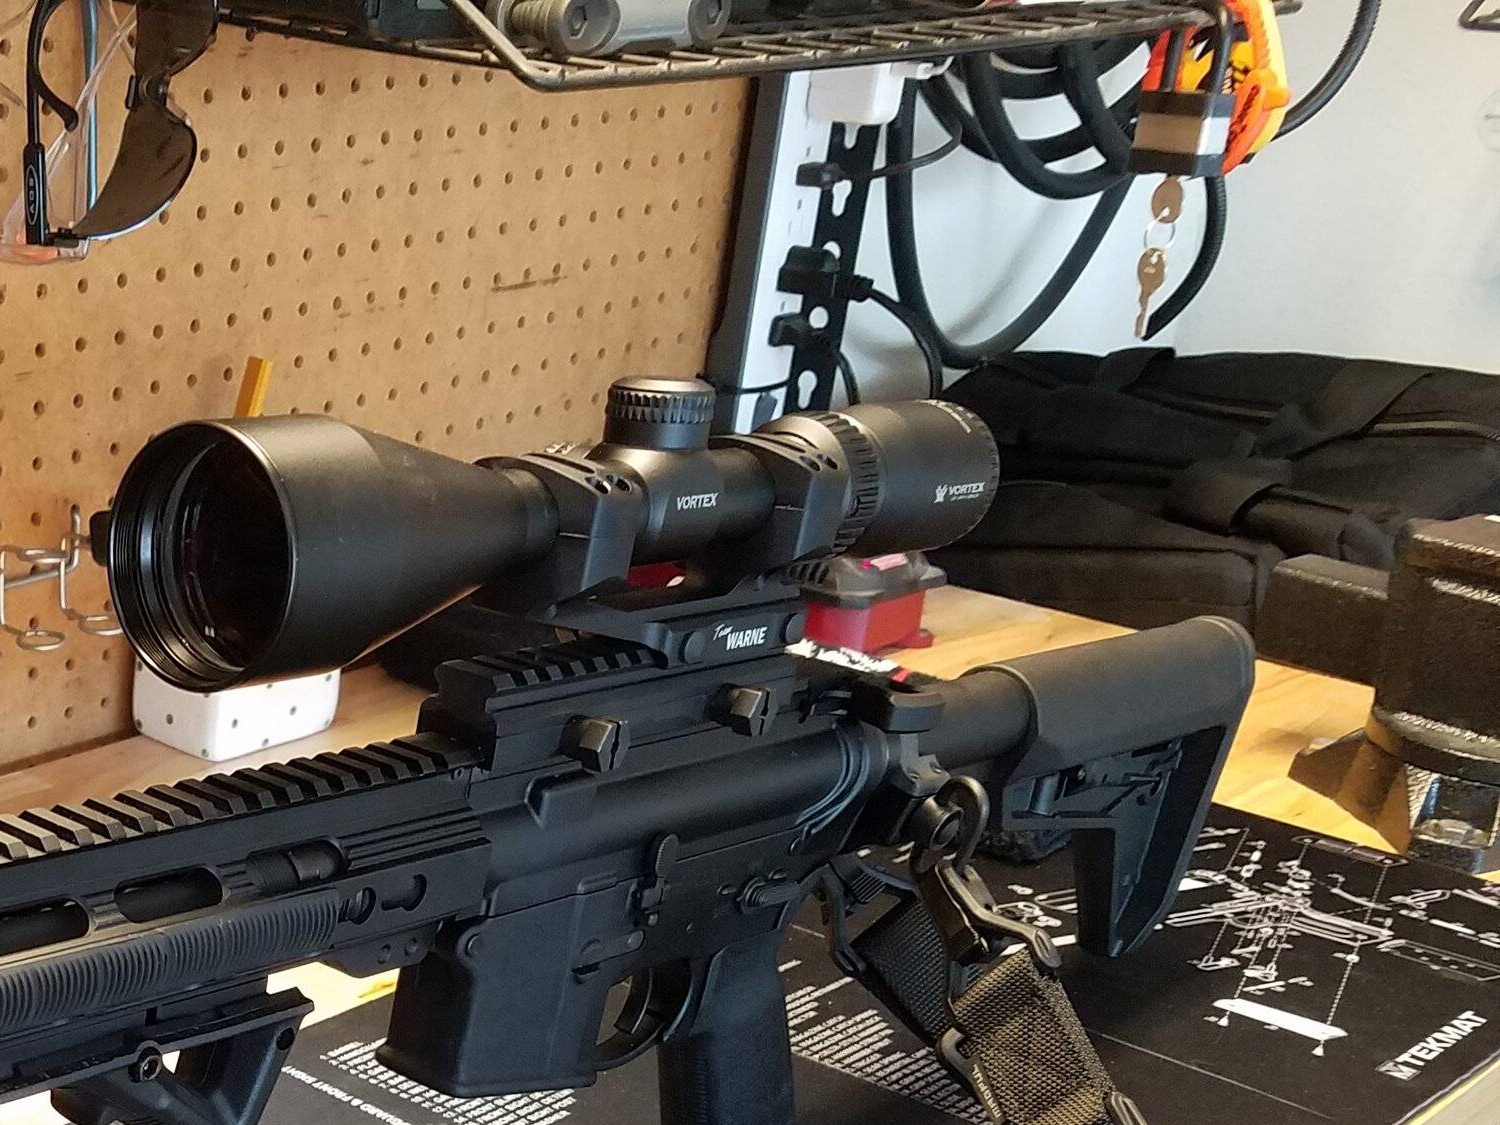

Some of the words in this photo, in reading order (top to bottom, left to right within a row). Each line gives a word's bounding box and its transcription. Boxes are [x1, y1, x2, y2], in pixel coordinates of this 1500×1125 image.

[948, 482, 986, 495] VORTEX
[676, 493, 718, 510] VORTEX
[726, 626, 767, 650] WARNE
[1395, 1010, 1488, 1066] TEKMAT
